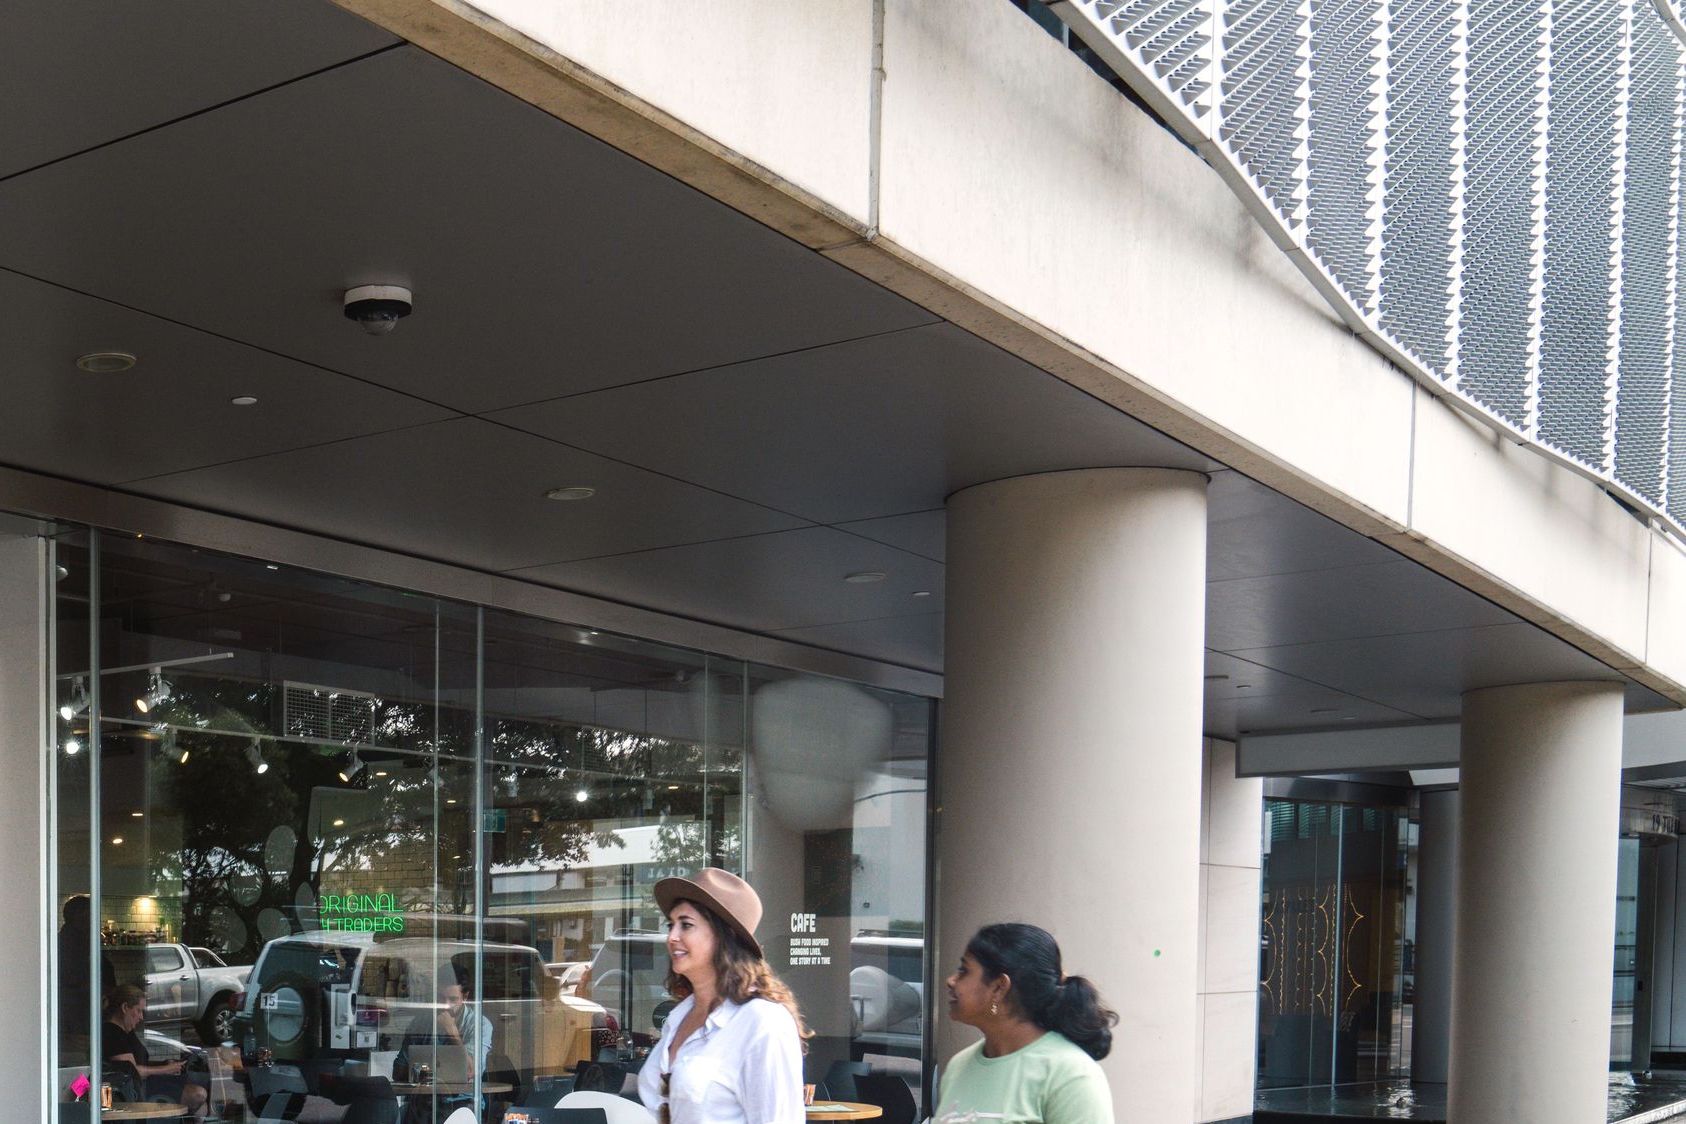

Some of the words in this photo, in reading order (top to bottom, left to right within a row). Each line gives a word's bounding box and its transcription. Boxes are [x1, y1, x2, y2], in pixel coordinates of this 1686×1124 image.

[333, 916, 404, 933] TRADERS
[790, 912, 816, 933] CAFE
[263, 994, 275, 1007] 15
